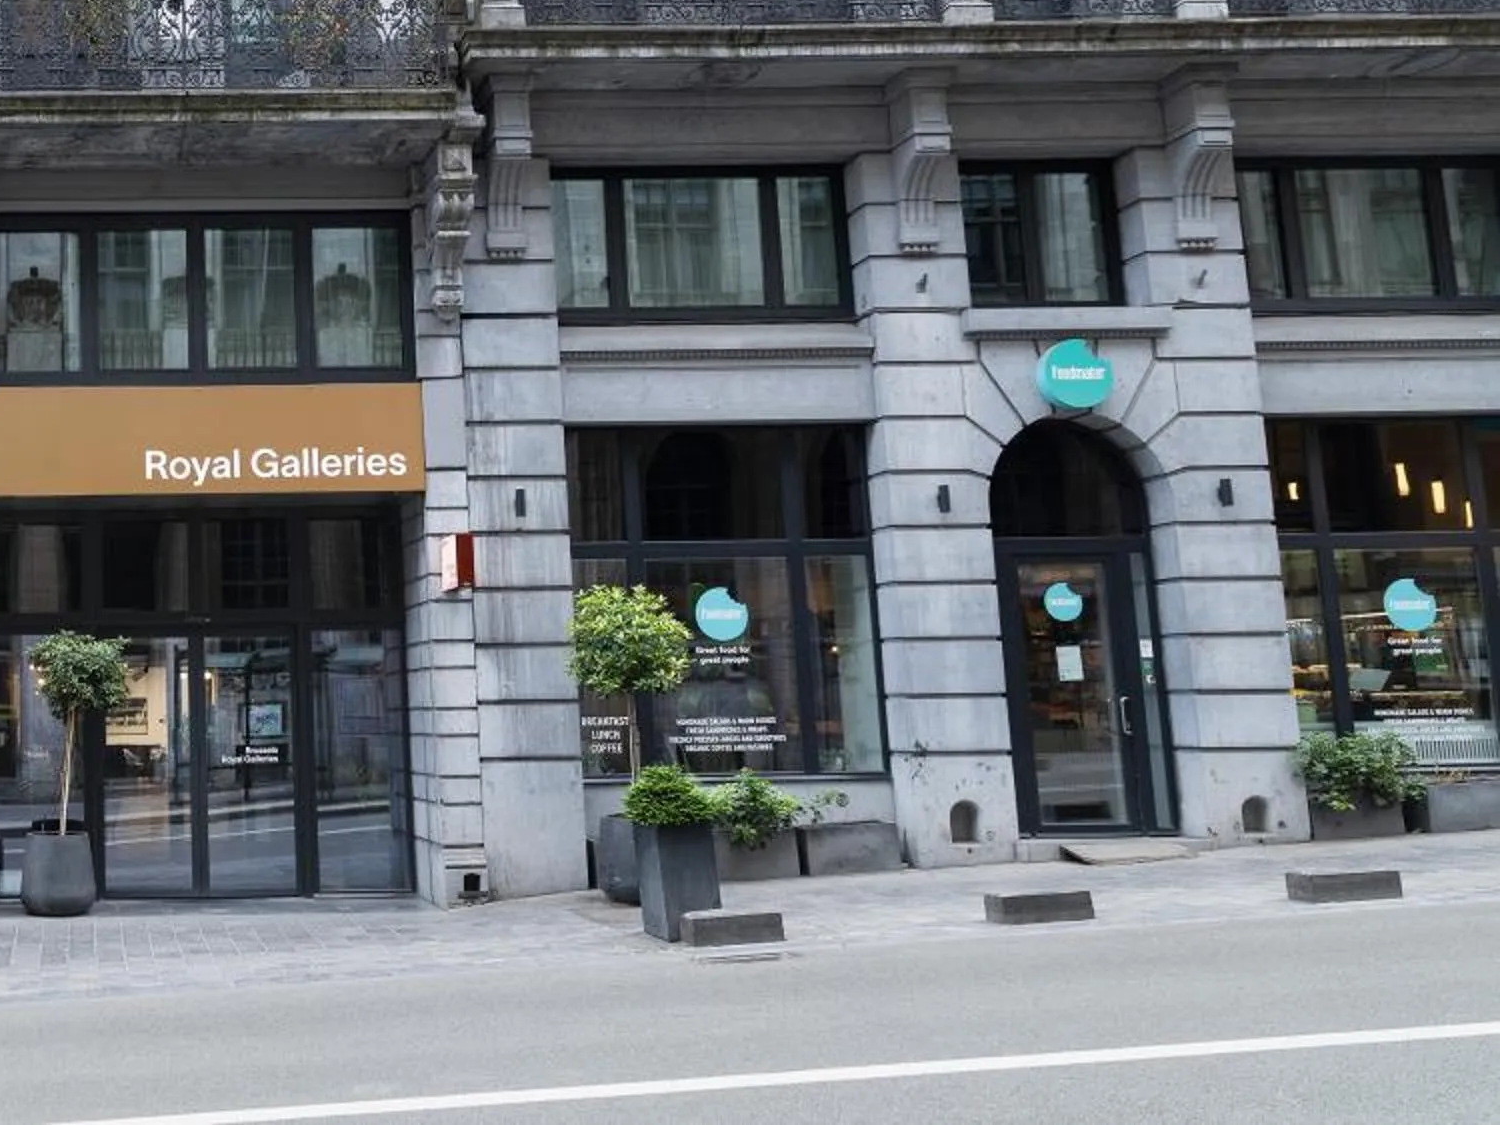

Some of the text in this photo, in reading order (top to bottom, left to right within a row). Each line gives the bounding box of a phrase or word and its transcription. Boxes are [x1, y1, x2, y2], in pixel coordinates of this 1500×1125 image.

[144, 446, 408, 487] Royal Galleries
[591, 730, 621, 740] LUNCH
[590, 742, 623, 754] COFFEE
